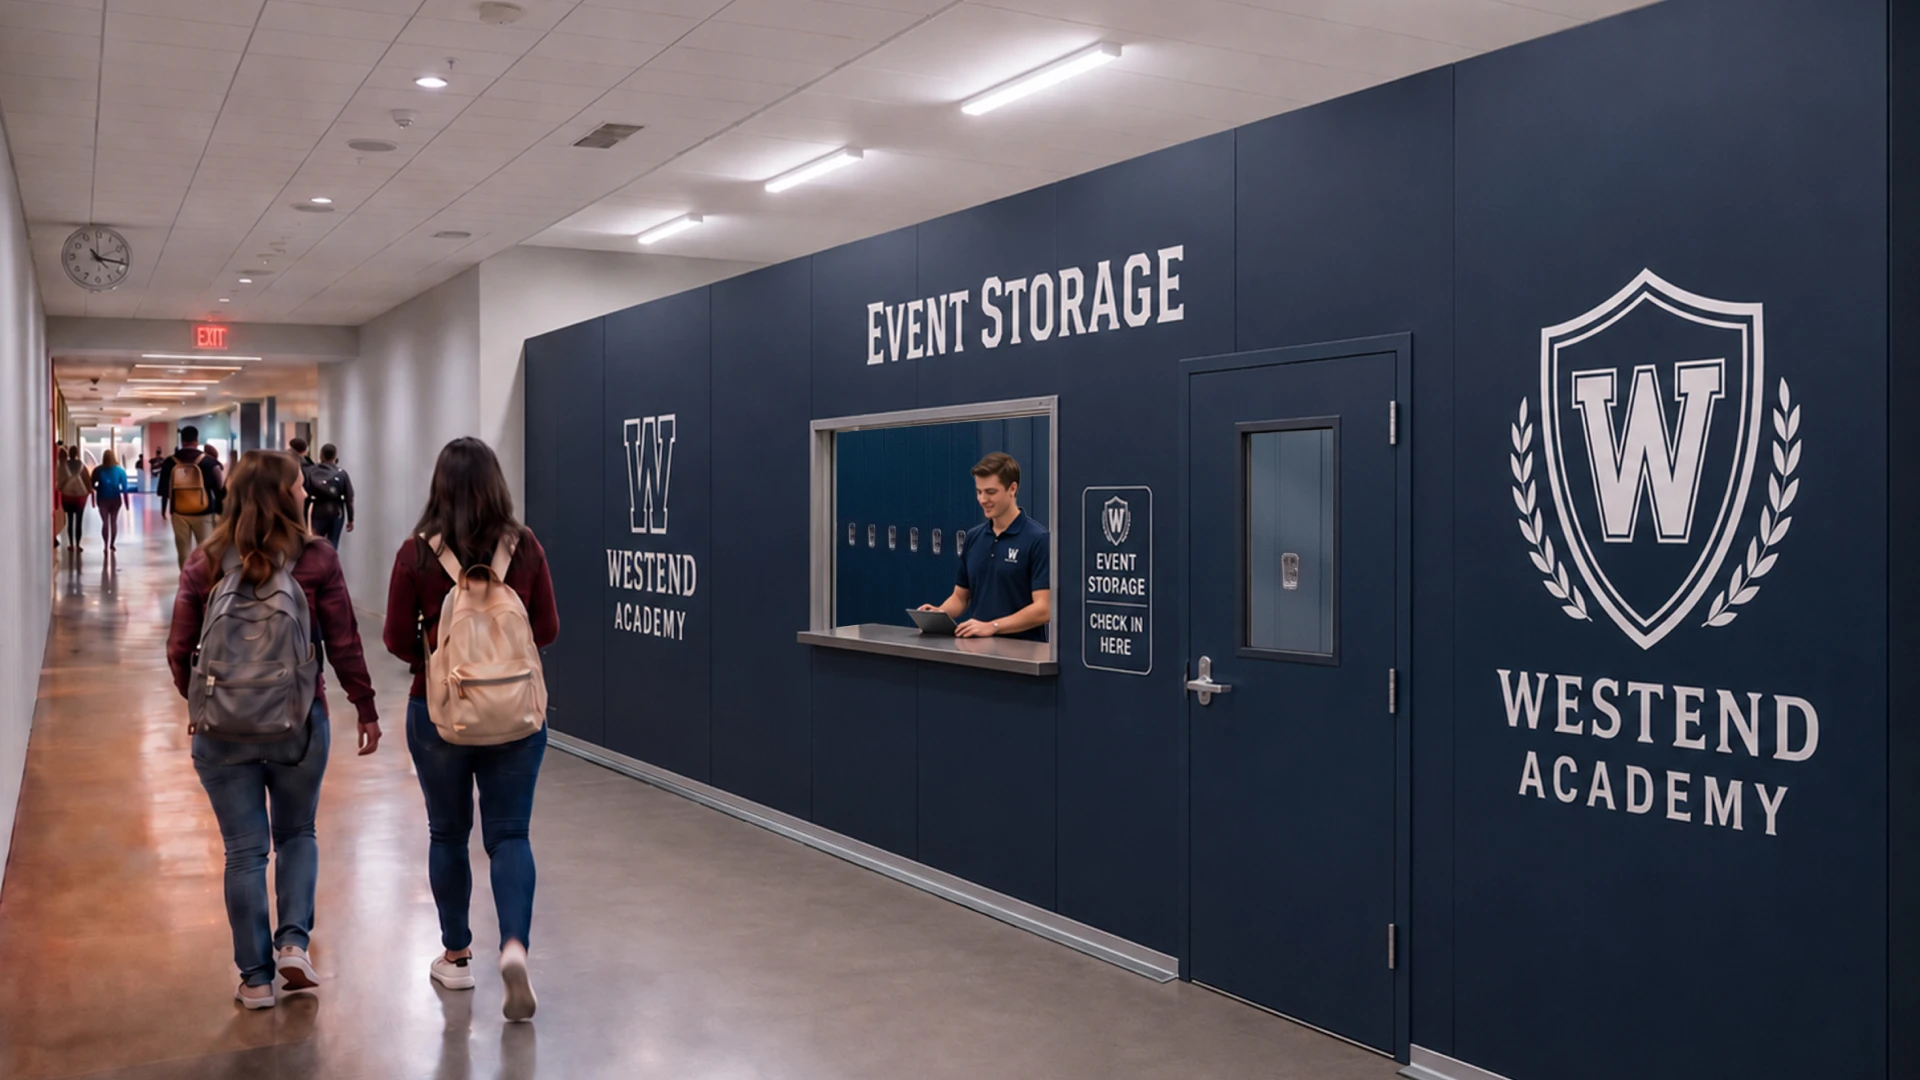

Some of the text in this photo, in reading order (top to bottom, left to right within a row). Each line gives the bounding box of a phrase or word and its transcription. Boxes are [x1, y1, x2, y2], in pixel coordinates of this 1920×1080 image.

[866, 244, 1185, 366] EVENT STORAGE
[197, 327, 227, 347] EXIT
[1571, 357, 1726, 544] W
[623, 413, 676, 535] W
[1108, 508, 1125, 533] W
[1008, 548, 1019, 560] W
[1096, 552, 1137, 571] EVENT
[606, 549, 697, 597] WESTEND
[1088, 575, 1146, 596] STORAGE
[614, 601, 686, 641] ACADEMY
[1089, 613, 1143, 633] CHECK IN
[1100, 636, 1132, 656] HERE
[1496, 668, 1819, 763] WESTEND
[1518, 750, 1789, 836] ACADEMY
